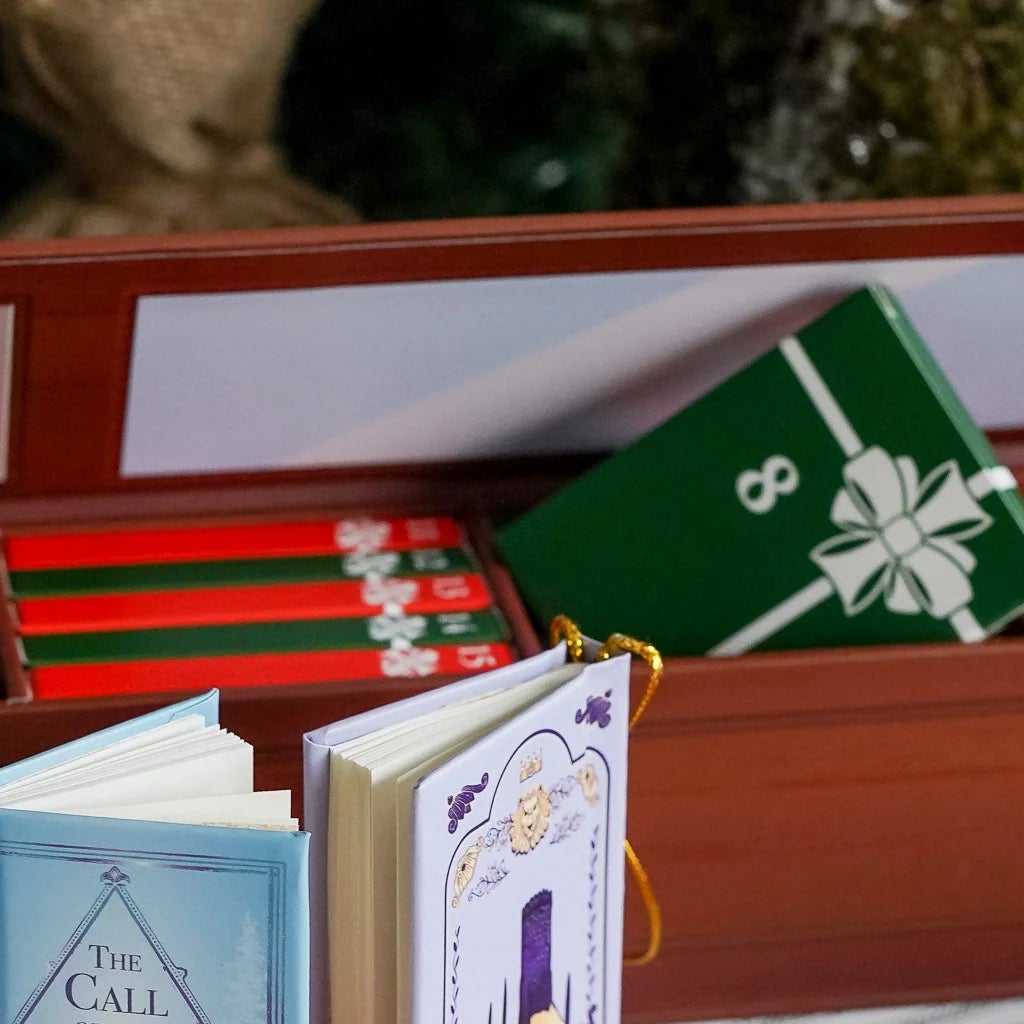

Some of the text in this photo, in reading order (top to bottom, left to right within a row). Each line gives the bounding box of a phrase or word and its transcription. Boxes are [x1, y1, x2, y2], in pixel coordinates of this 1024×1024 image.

[735, 454, 800, 515] 8
[88, 943, 143, 973] THE
[64, 971, 170, 1018] CALL
